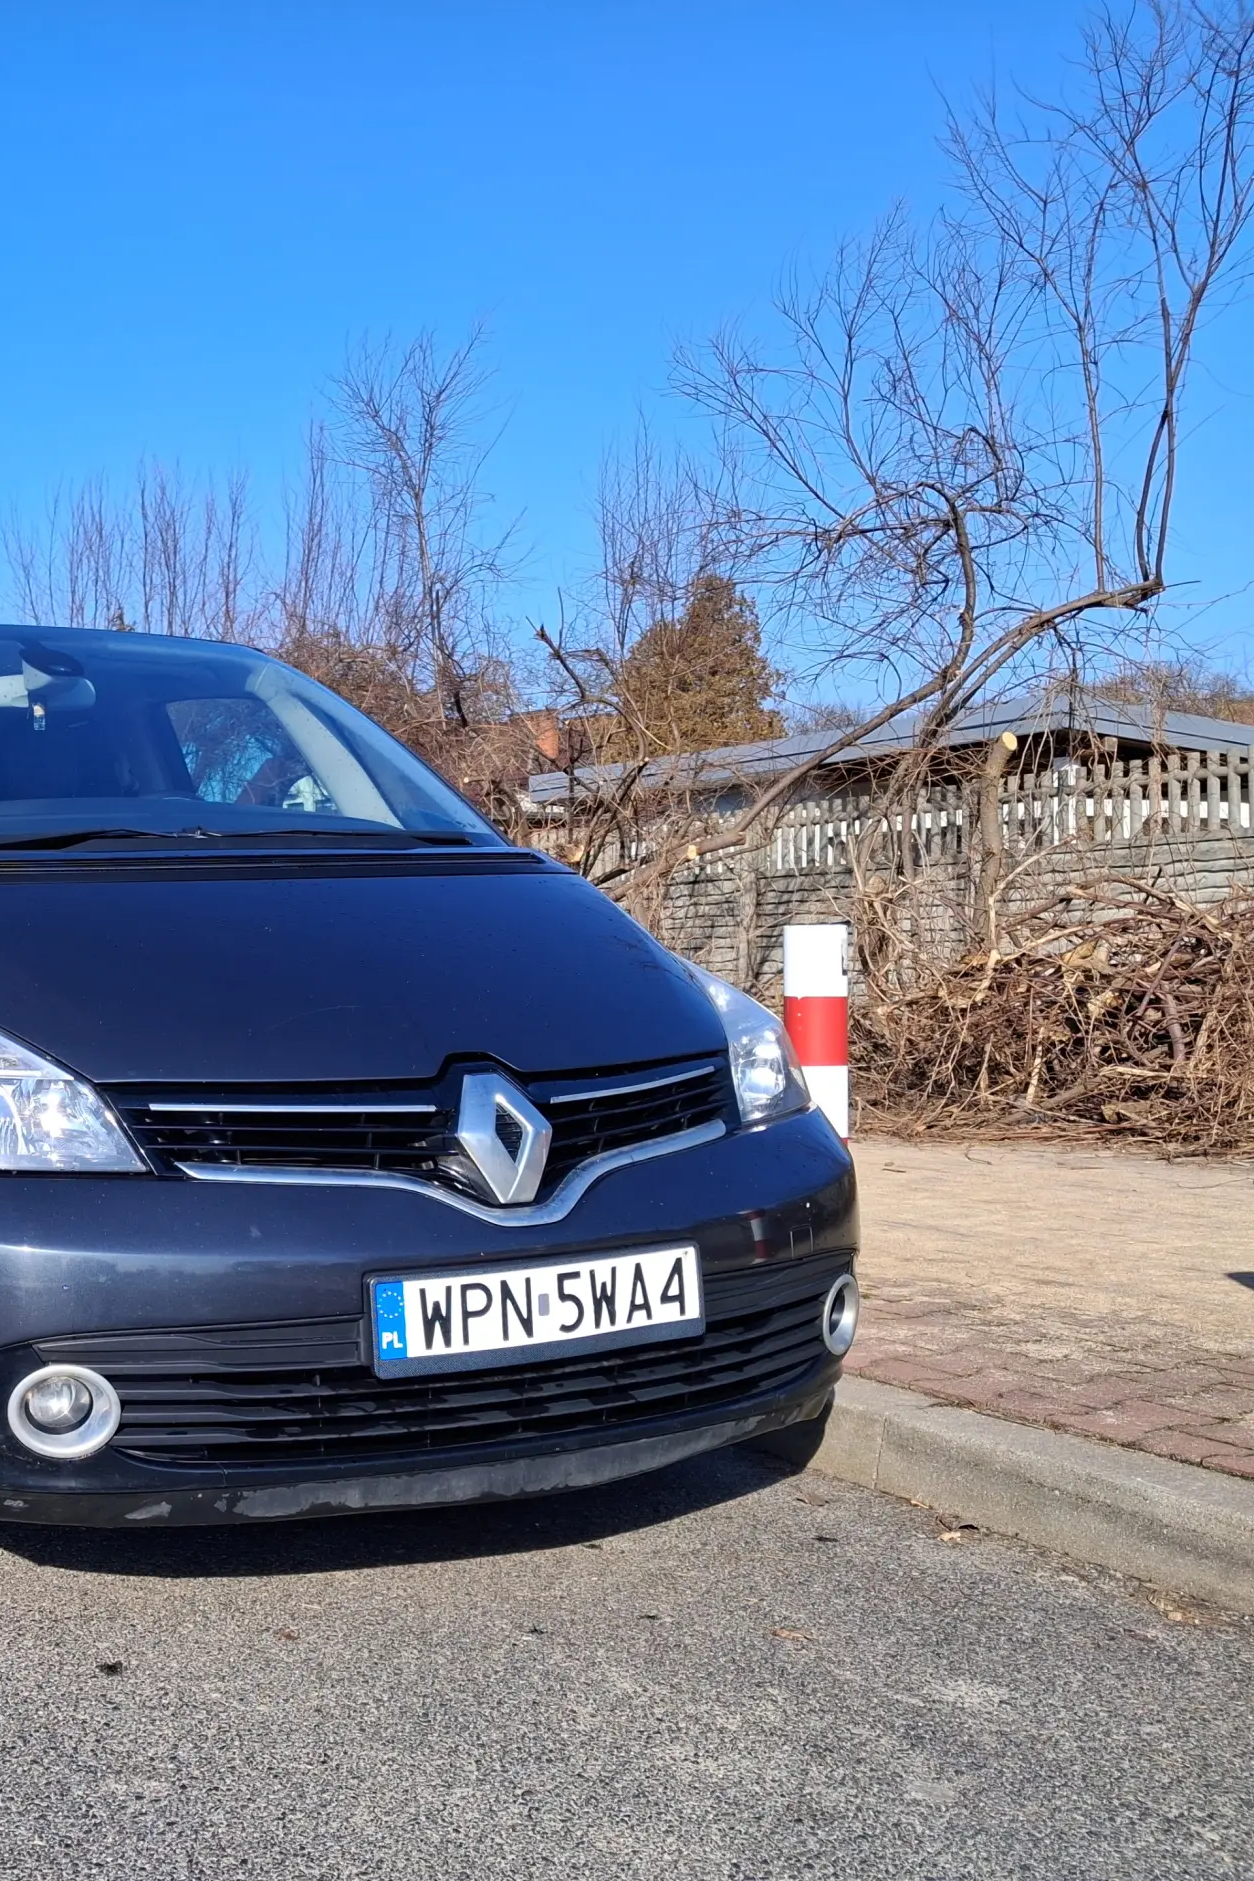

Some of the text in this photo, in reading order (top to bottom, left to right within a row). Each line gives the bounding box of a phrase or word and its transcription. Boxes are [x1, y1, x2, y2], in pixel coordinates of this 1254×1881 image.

[419, 1257, 687, 1351] WPN 5WA4
[381, 1331, 404, 1350] PL
